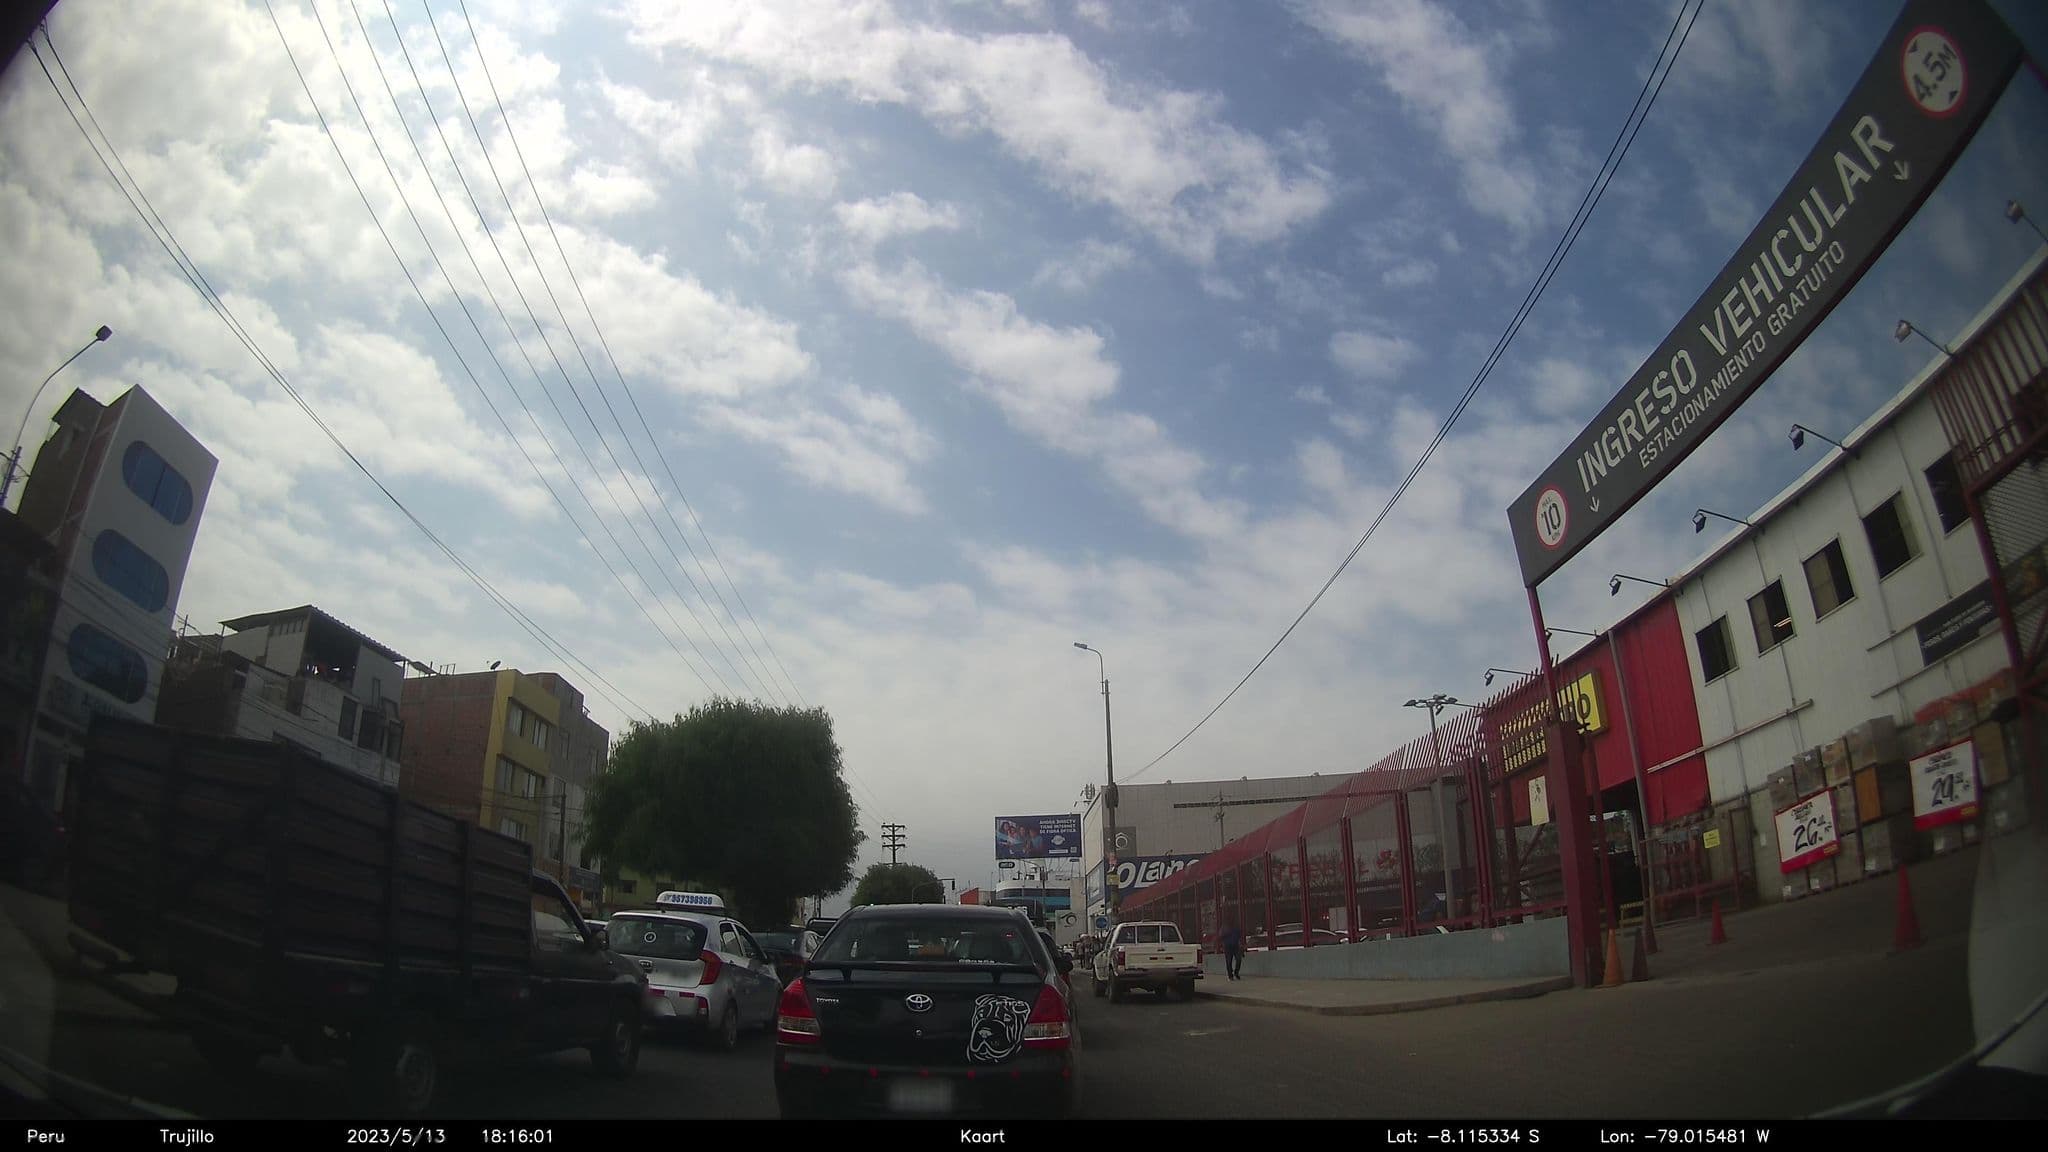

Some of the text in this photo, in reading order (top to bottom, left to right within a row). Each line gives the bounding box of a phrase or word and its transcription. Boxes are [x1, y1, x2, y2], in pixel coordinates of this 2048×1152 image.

[1576, 115, 1894, 493] INGRESO VEHICULAR
[1638, 240, 1845, 468] ESTACIONAMIENTO GRATUITO
[1540, 502, 1561, 536] 10
